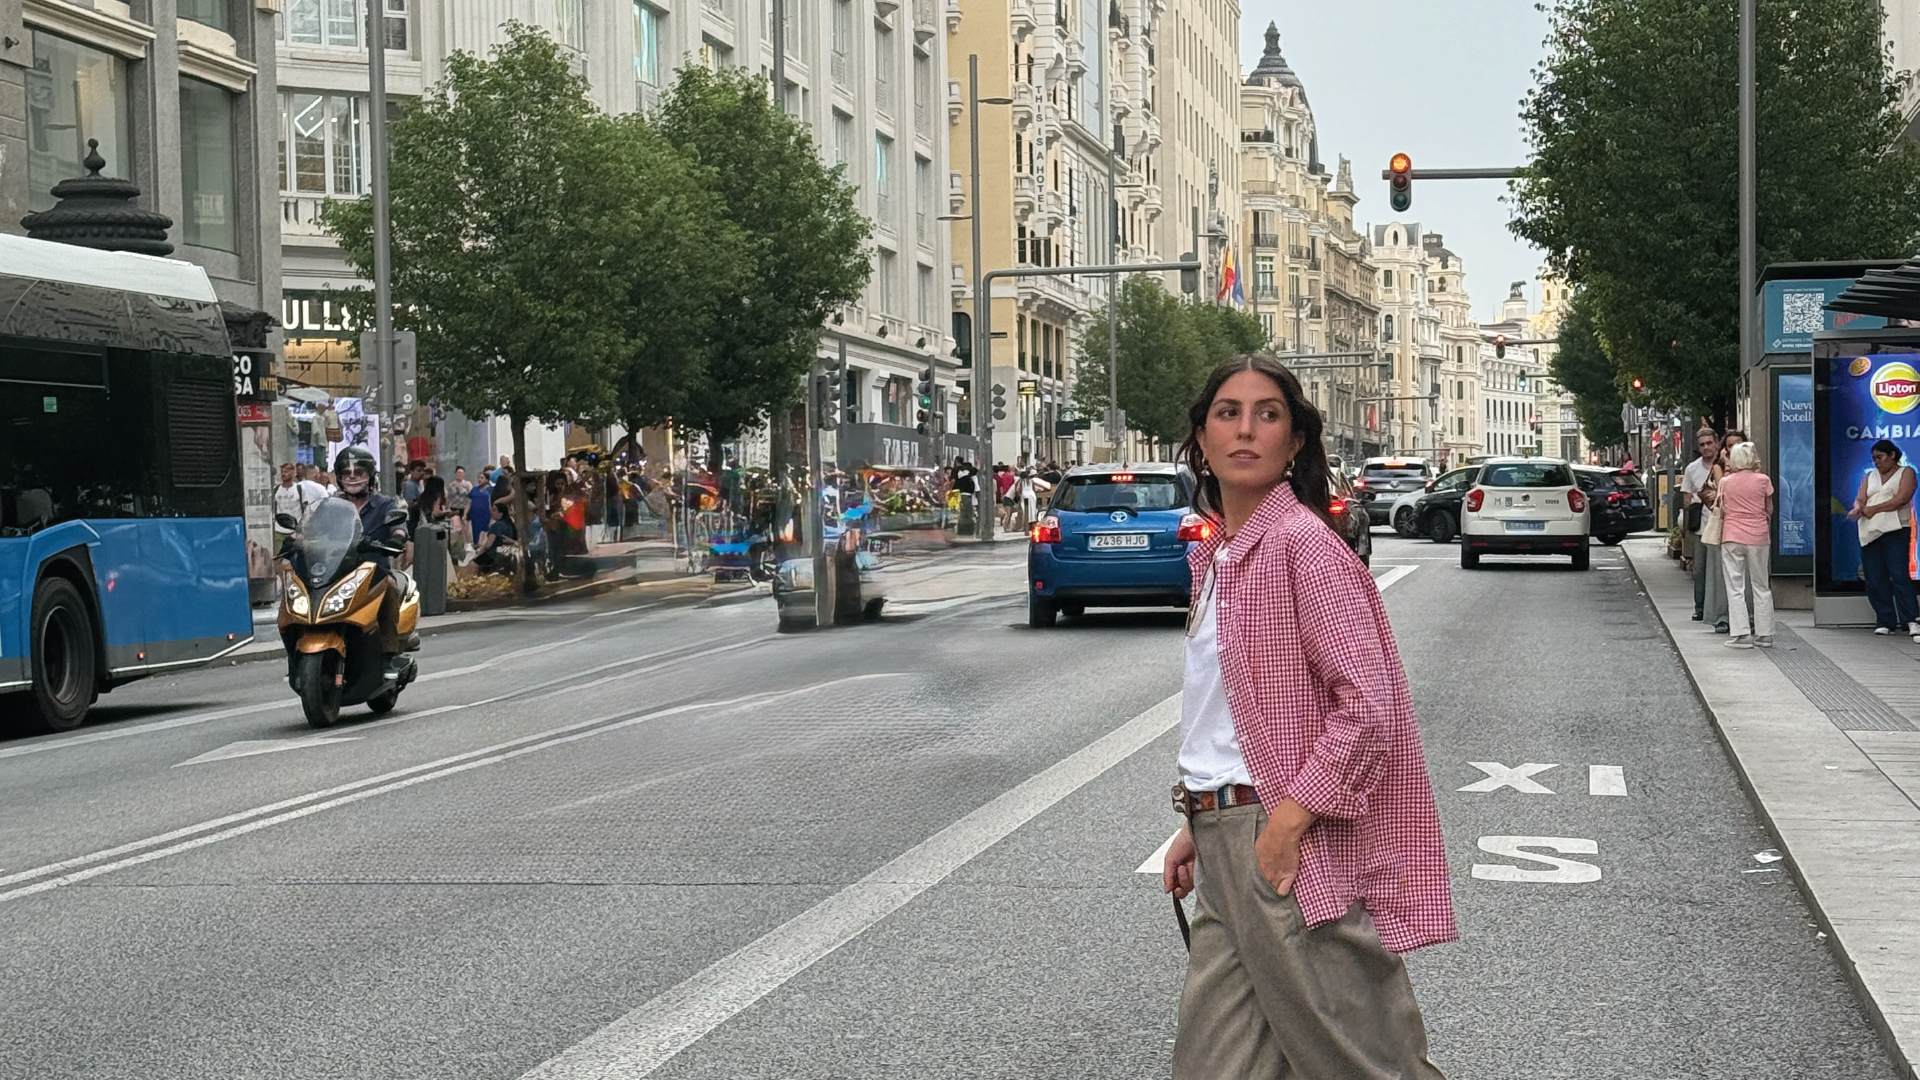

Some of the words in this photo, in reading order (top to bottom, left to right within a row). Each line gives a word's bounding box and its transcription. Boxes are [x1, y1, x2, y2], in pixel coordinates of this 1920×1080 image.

[1035, 85, 1043, 122] THIS
[1036, 127, 1044, 146] IS
[1036, 152, 1044, 160] A
[1036, 166, 1045, 213] HOTEL
[1879, 383, 1916, 396] Lipton
[1781, 411, 1813, 423] botell
[1096, 535, 1122, 546] 2436
[1125, 534, 1146, 546] HJG
